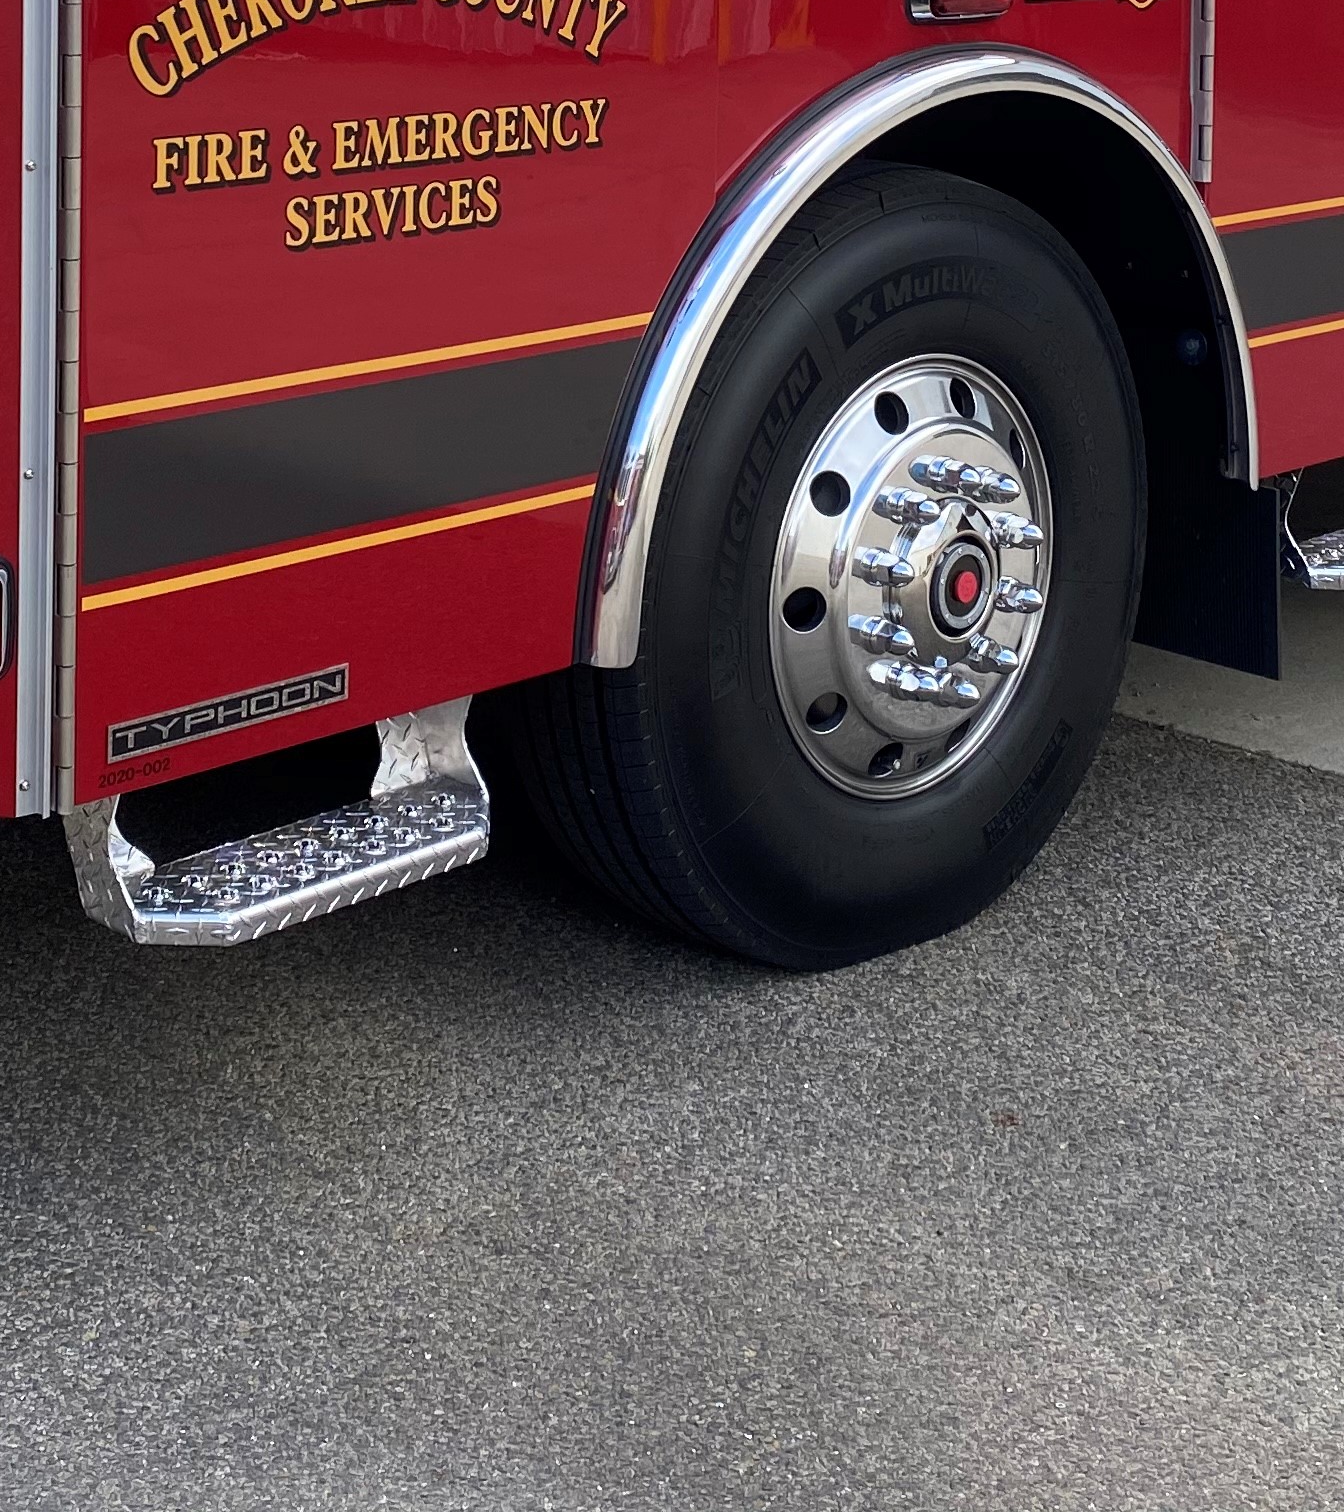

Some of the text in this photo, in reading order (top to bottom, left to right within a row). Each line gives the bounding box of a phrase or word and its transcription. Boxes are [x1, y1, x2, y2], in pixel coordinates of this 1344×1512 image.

[152, 97, 609, 192] FIRE & EMERGENCY
[284, 174, 500, 249] SERVICES
[115, 674, 342, 749] TYPHOON
[99, 756, 171, 788] 2020-002
